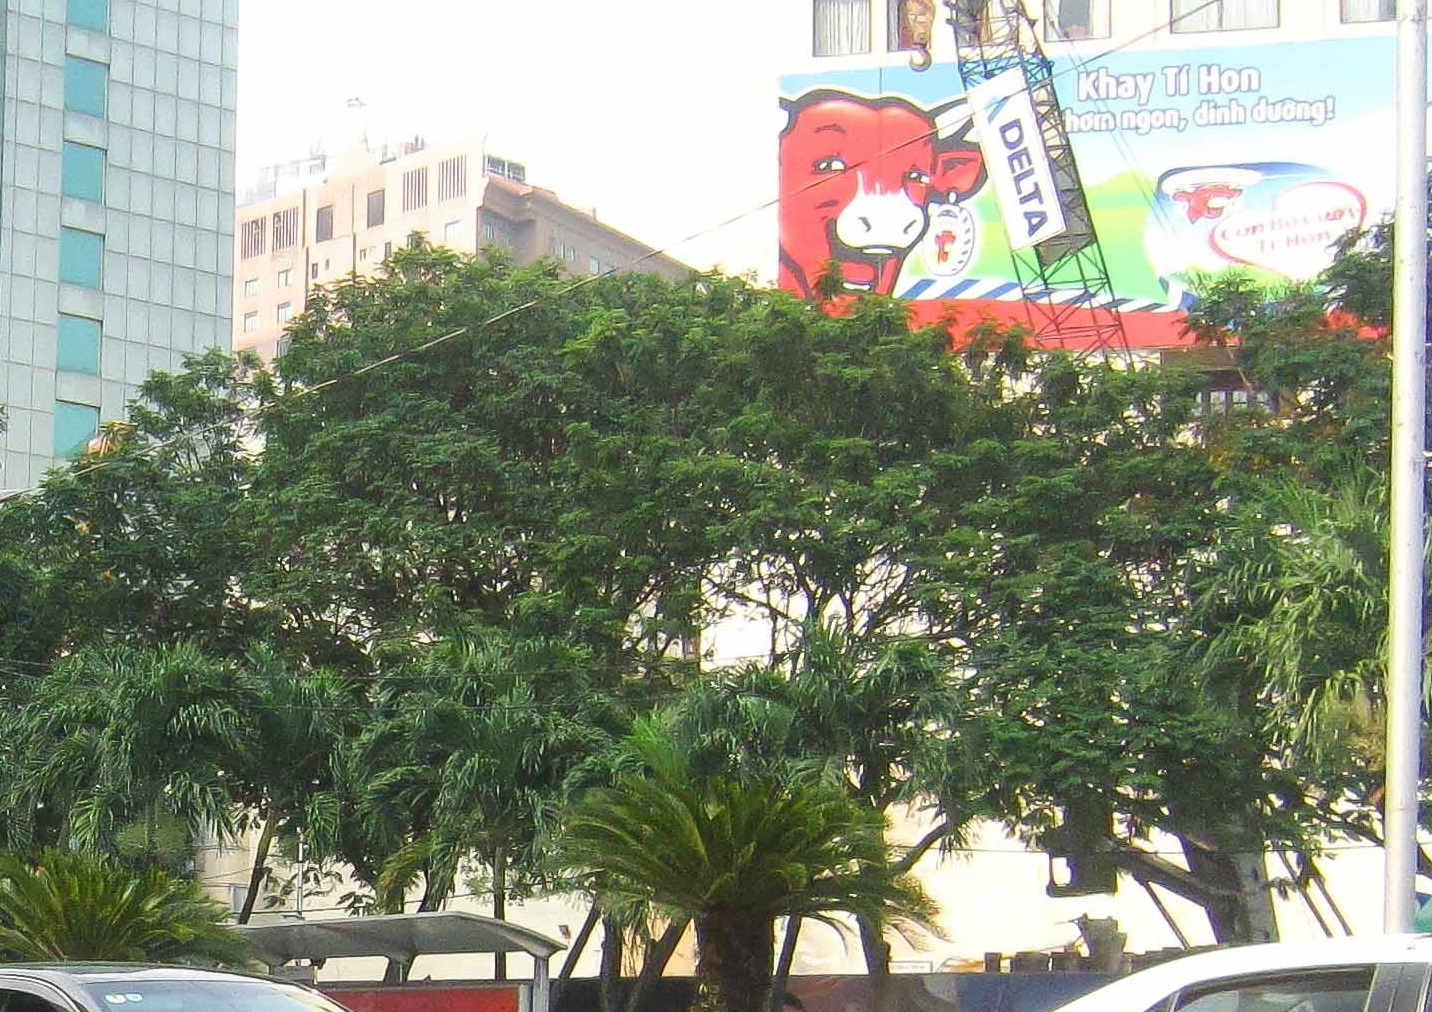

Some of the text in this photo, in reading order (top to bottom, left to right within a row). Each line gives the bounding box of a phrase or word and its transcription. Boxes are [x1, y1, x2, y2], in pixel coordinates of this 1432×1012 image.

[1077, 64, 1261, 105] Khay Tí Hon
[1064, 107, 1116, 133] hơm
[1120, 108, 1188, 135] ngon,
[999, 117, 1049, 238] DELTA
